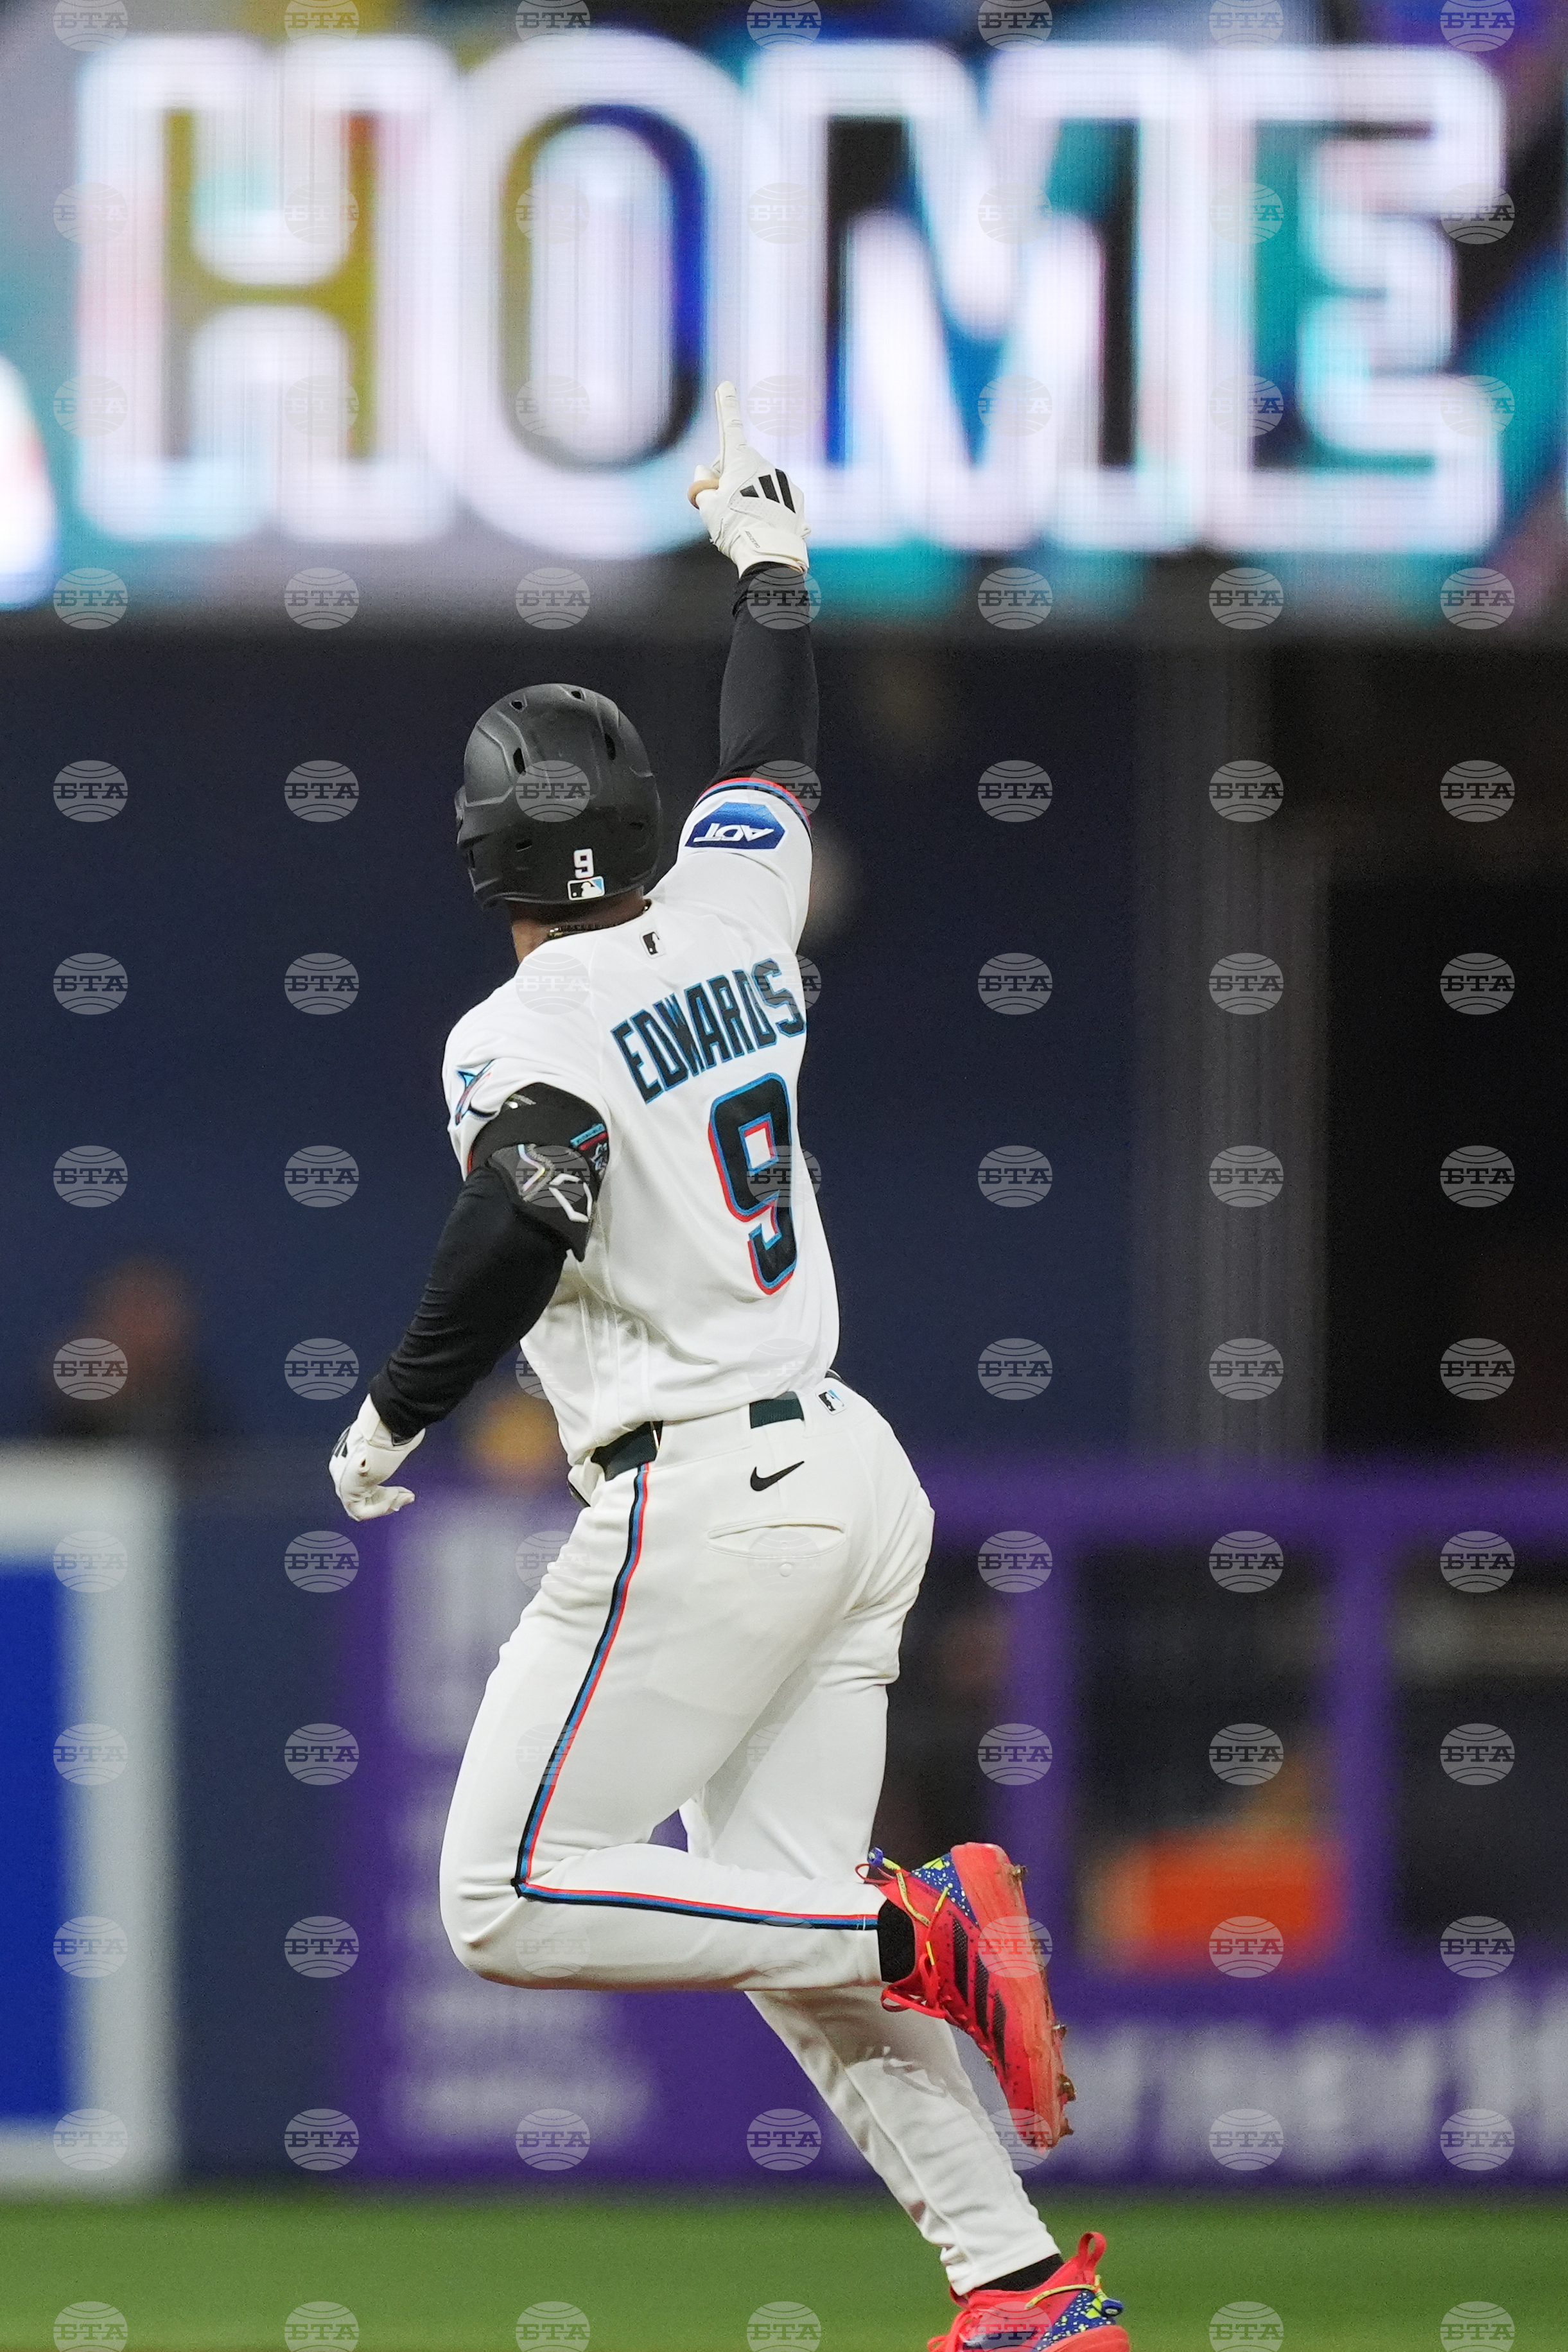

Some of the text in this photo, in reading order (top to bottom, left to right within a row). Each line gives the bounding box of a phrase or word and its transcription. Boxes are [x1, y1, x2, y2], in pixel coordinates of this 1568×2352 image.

[76, 33, 1505, 559] HOME
[573, 848, 595, 879] 9
[693, 823, 774, 842] ADT
[611, 958, 807, 1104] EDWARDS
[708, 1072, 797, 1295] 9
